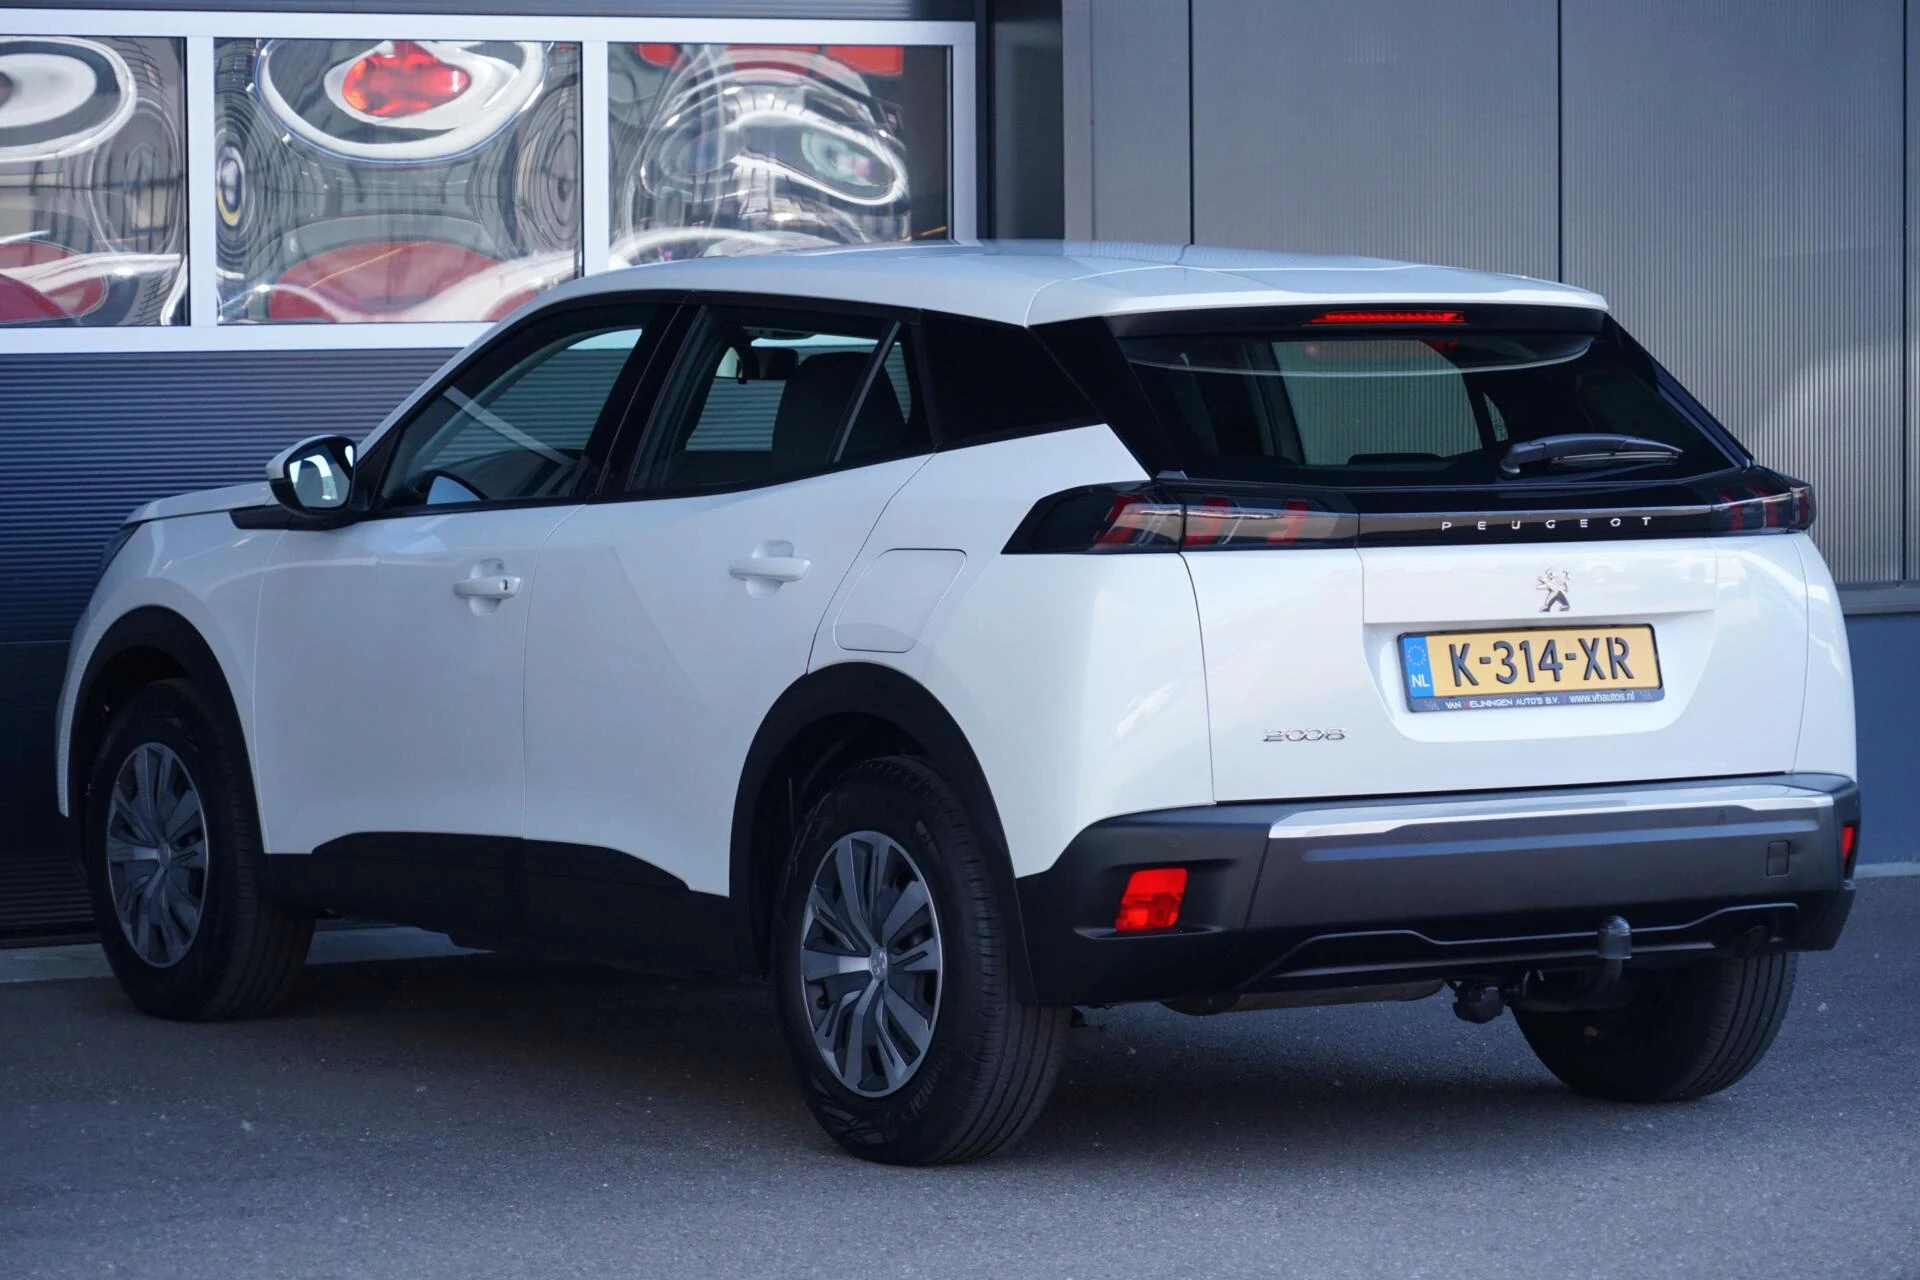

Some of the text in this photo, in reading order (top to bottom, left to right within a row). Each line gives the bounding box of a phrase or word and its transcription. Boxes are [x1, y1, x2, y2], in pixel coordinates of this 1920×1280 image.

[1441, 516, 1652, 531] PEUGEOT
[1448, 636, 1634, 687] K-314-XR
[1411, 674, 1430, 689] NL
[1445, 700, 1462, 710] VAN
[1515, 697, 1543, 706] AUTO'S
[1545, 696, 1560, 705] B.V.
[1569, 691, 1635, 704] www.vhautos.nl
[1262, 728, 1346, 742] 2008
